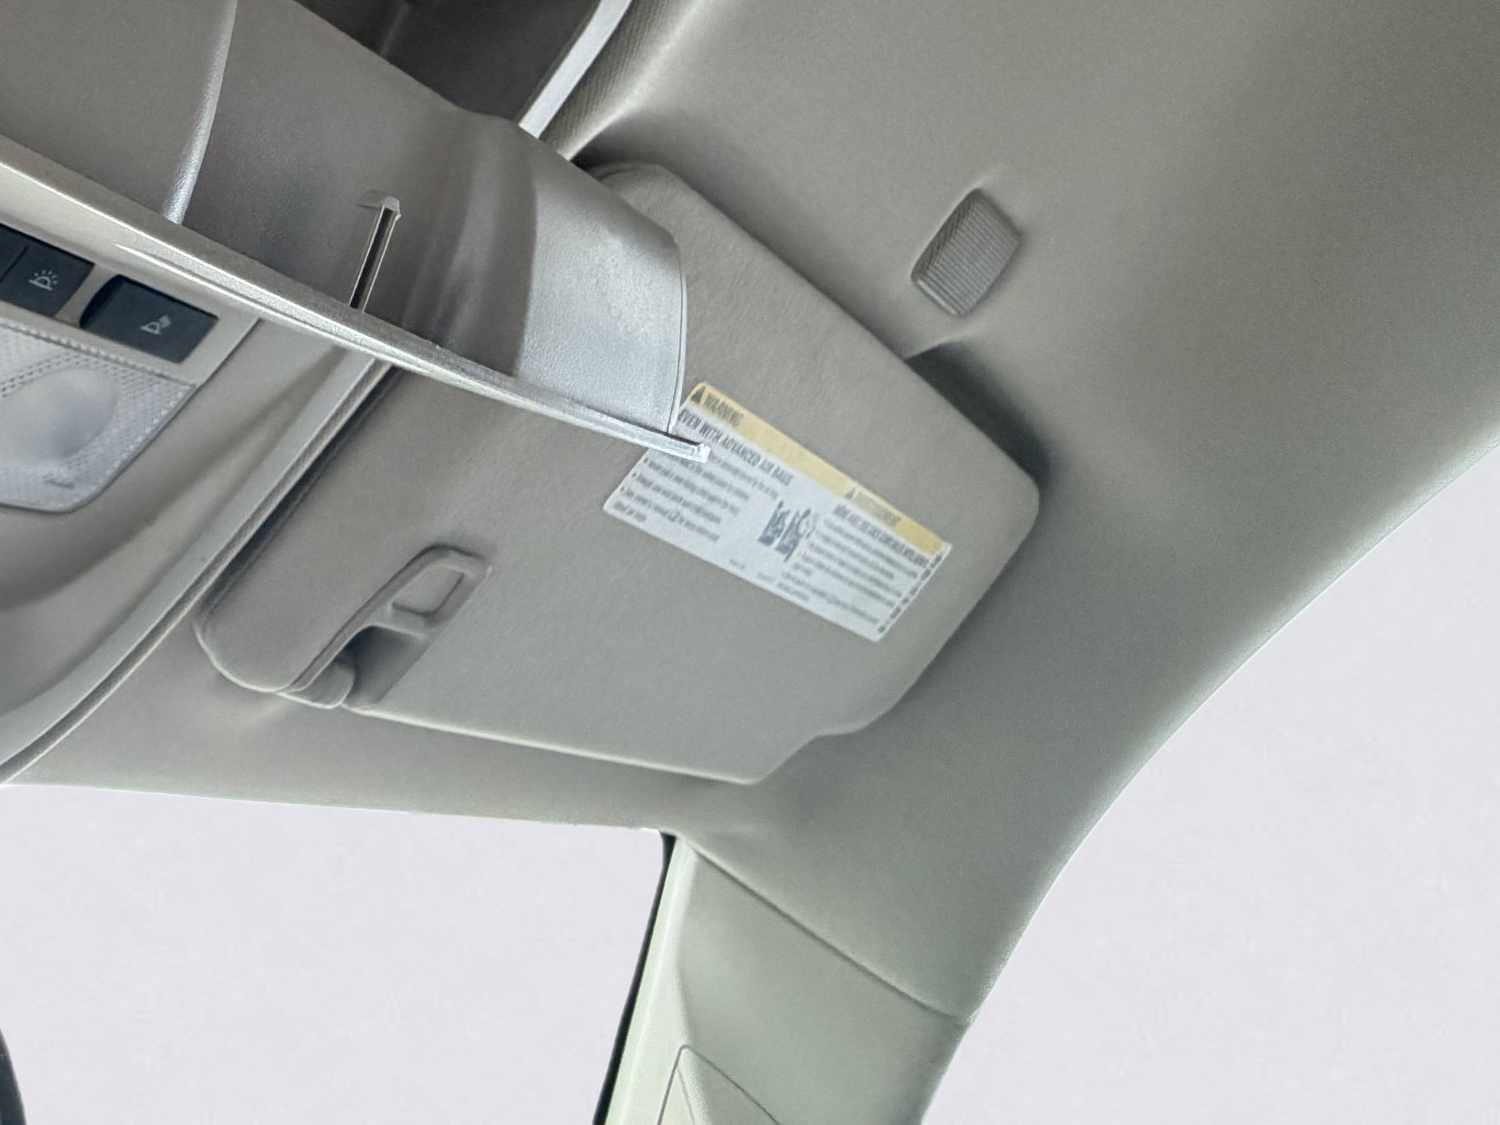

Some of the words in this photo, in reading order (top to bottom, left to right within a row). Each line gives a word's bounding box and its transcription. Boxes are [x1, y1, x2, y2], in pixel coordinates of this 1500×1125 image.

[705, 392, 744, 428] WARNING
[677, 408, 702, 430] EVEN
[699, 422, 723, 443] WITH
[721, 435, 761, 466] ADVANCED
[758, 458, 774, 473] AIR
[771, 466, 794, 486] BAGS
